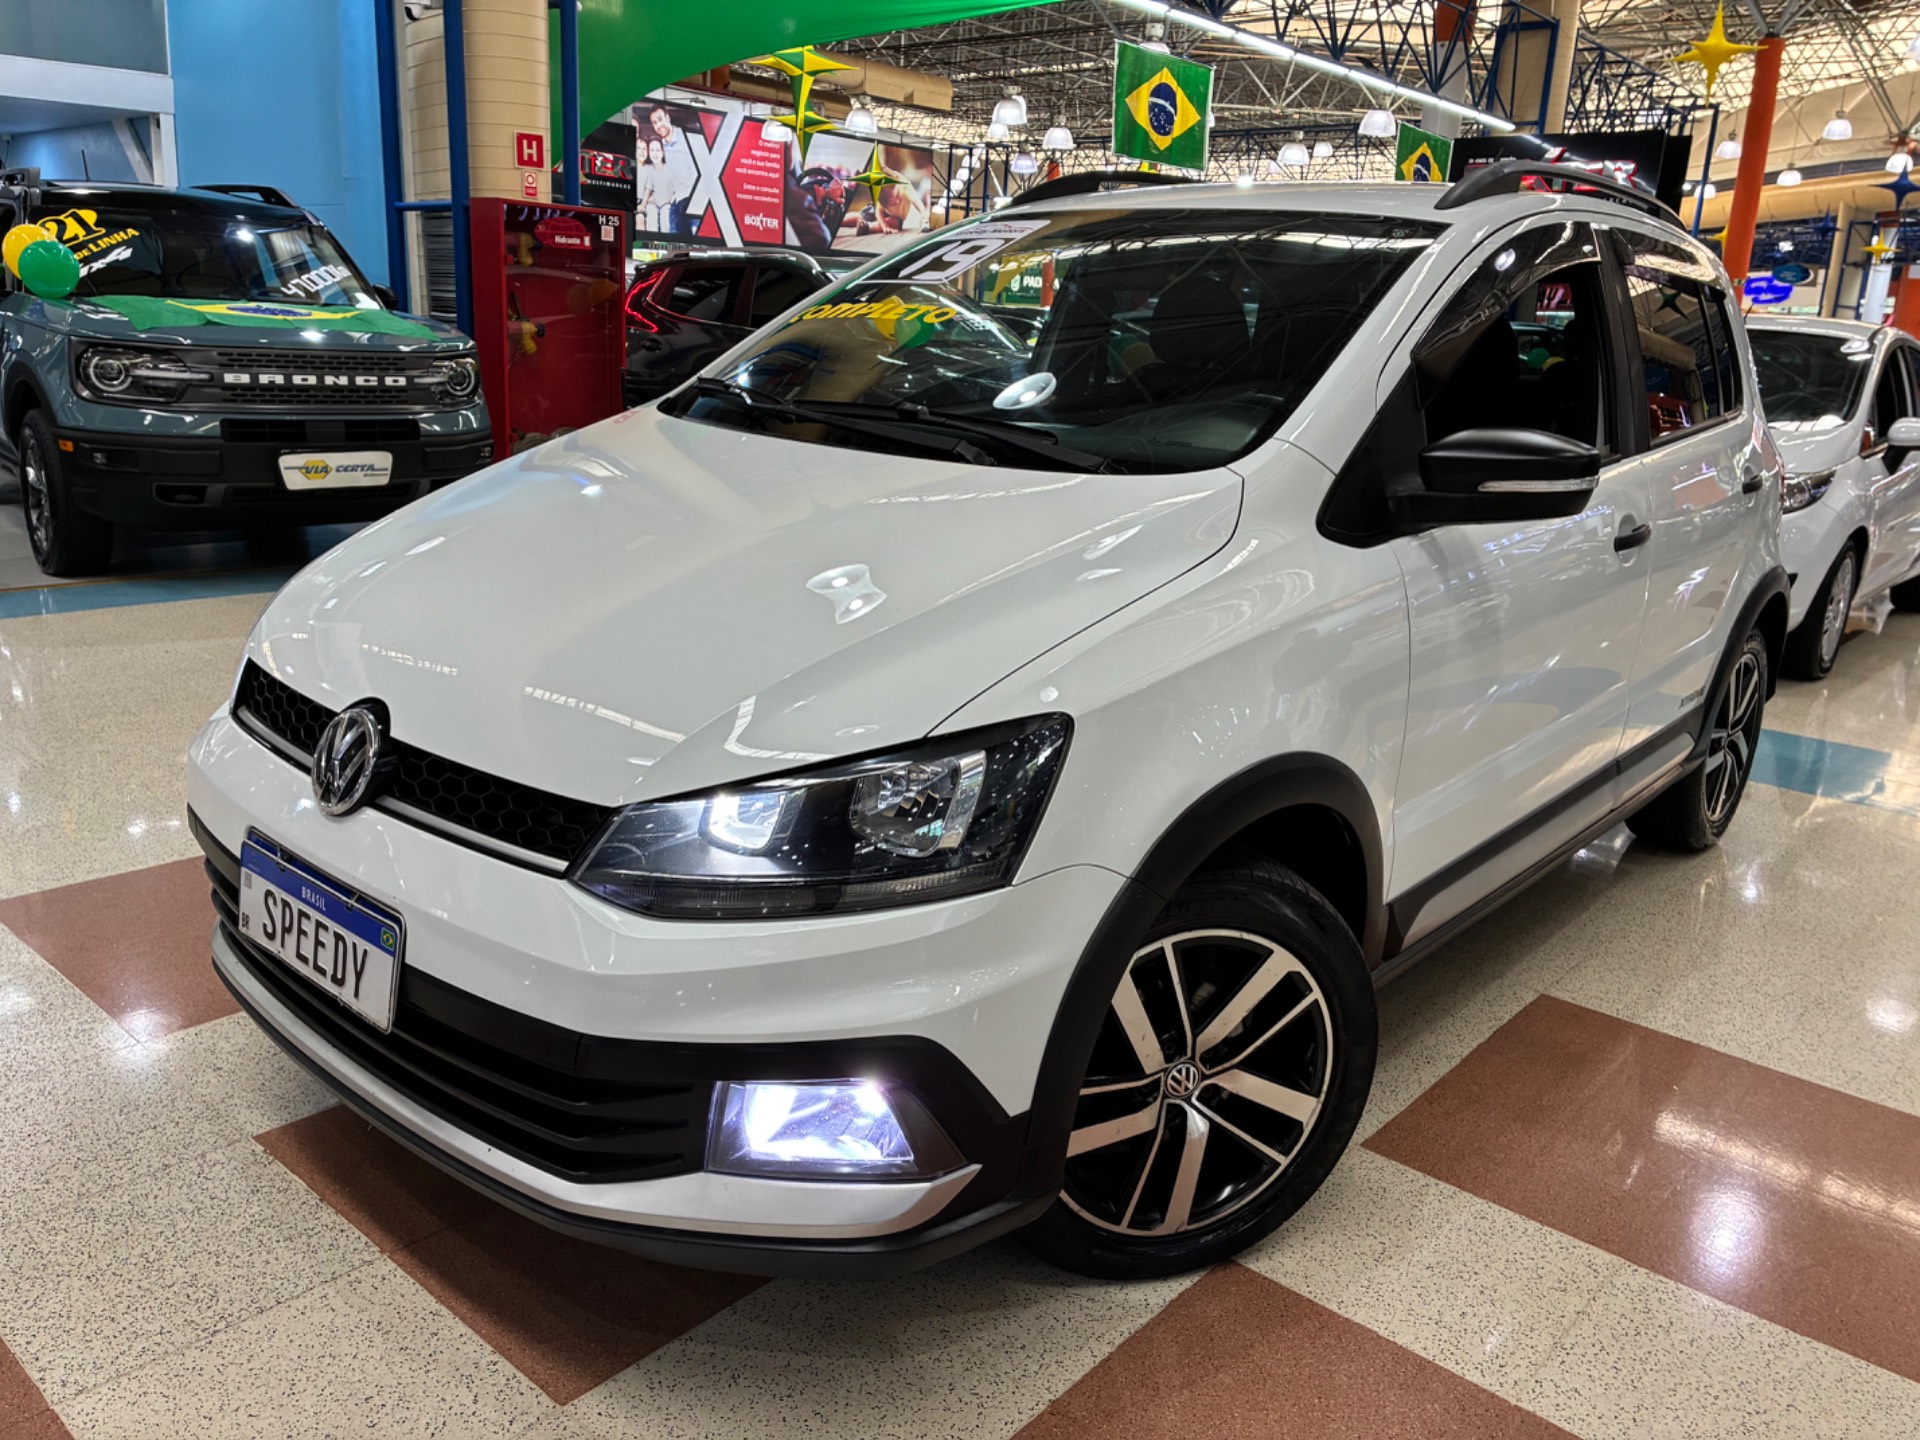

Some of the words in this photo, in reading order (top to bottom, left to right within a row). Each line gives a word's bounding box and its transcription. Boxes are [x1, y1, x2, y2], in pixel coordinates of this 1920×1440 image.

[522, 139, 538, 162] H
[599, 215, 608, 226] H
[608, 215, 620, 226] 25
[744, 212, 779, 231] BOXTER
[88, 227, 140, 253] LINHA
[554, 234, 582, 245] Hidrante
[898, 238, 1006, 280] 19
[223, 372, 407, 387] BRONCO
[304, 465, 330, 475] VIA
[335, 463, 375, 473] CERTA
[301, 885, 327, 912] BRASIL
[241, 911, 250, 930] BR
[261, 888, 368, 1000] SPEEDY
